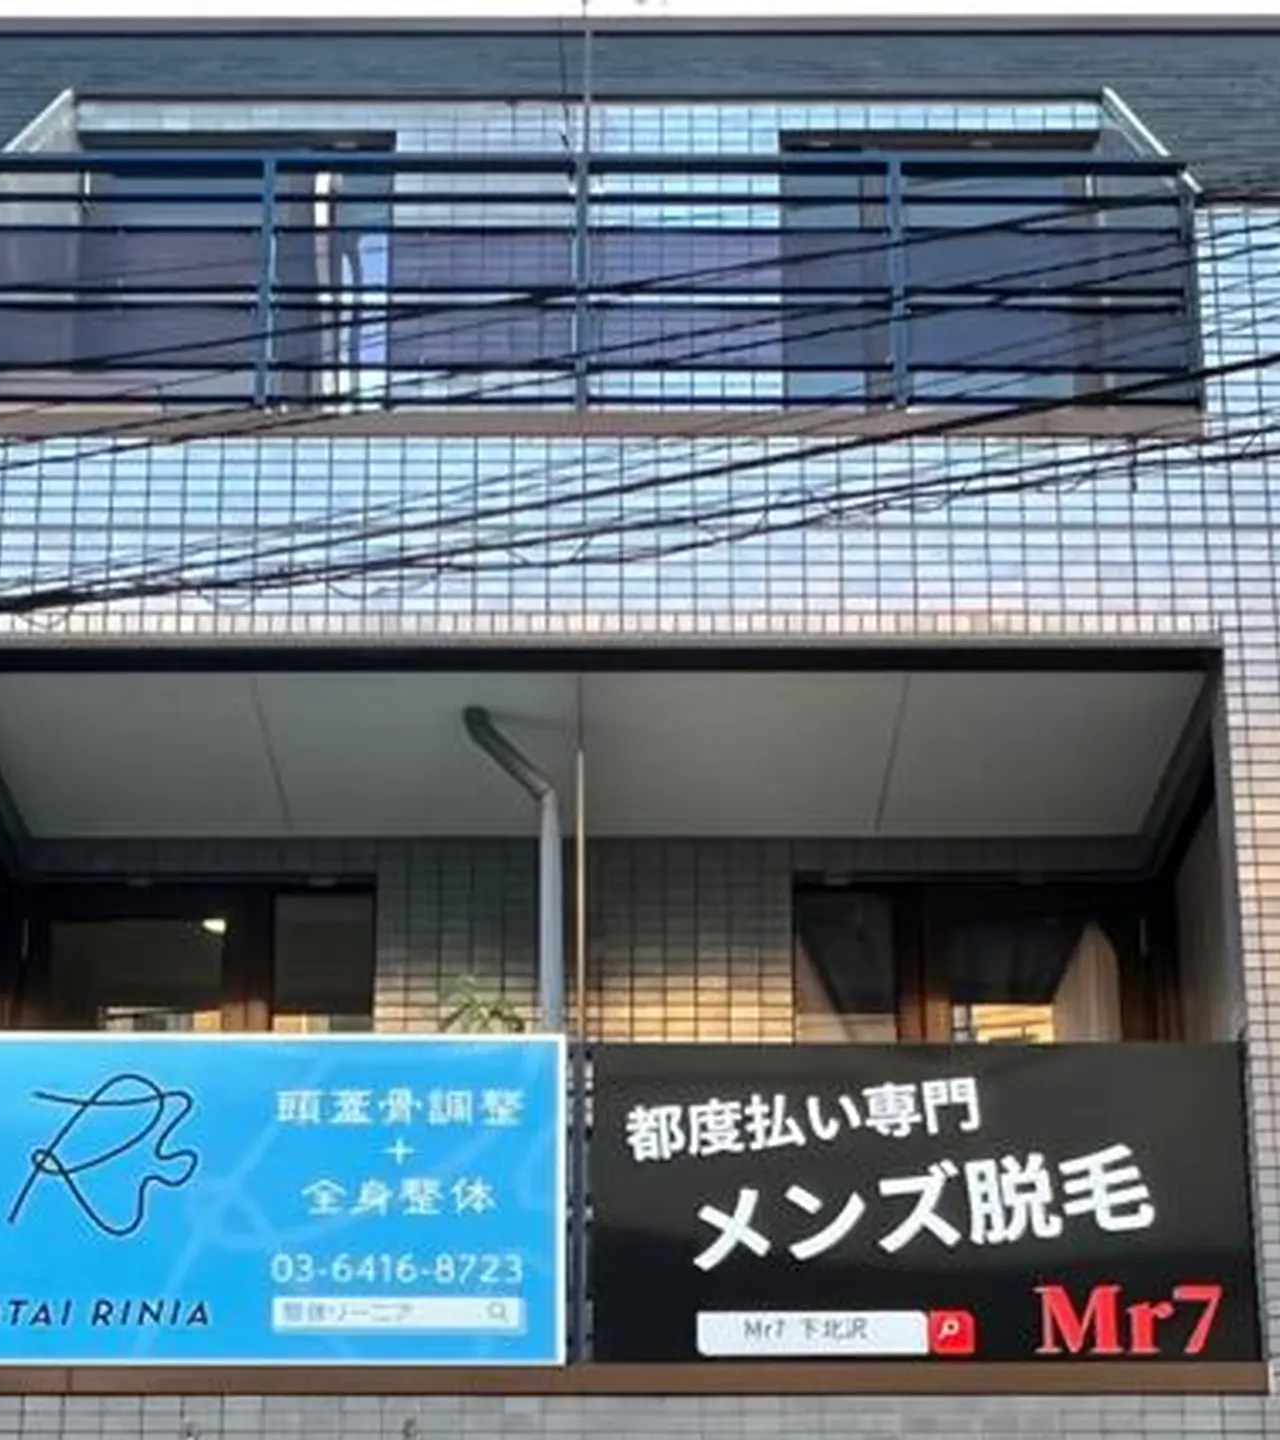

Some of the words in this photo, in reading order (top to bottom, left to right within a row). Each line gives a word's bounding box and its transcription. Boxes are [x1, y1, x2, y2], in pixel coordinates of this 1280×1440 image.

[275, 1088, 524, 1127] 頭蓋骨調整
[625, 1076, 980, 1162] 都度払い専門
[300, 1177, 499, 1216] 全身整体
[692, 1143, 1157, 1273] メンズ脱毛
[270, 1253, 524, 1285] 03-6416-8723
[91, 1299, 211, 1328] RINIA
[1034, 1283, 1222, 1355] Mr7
